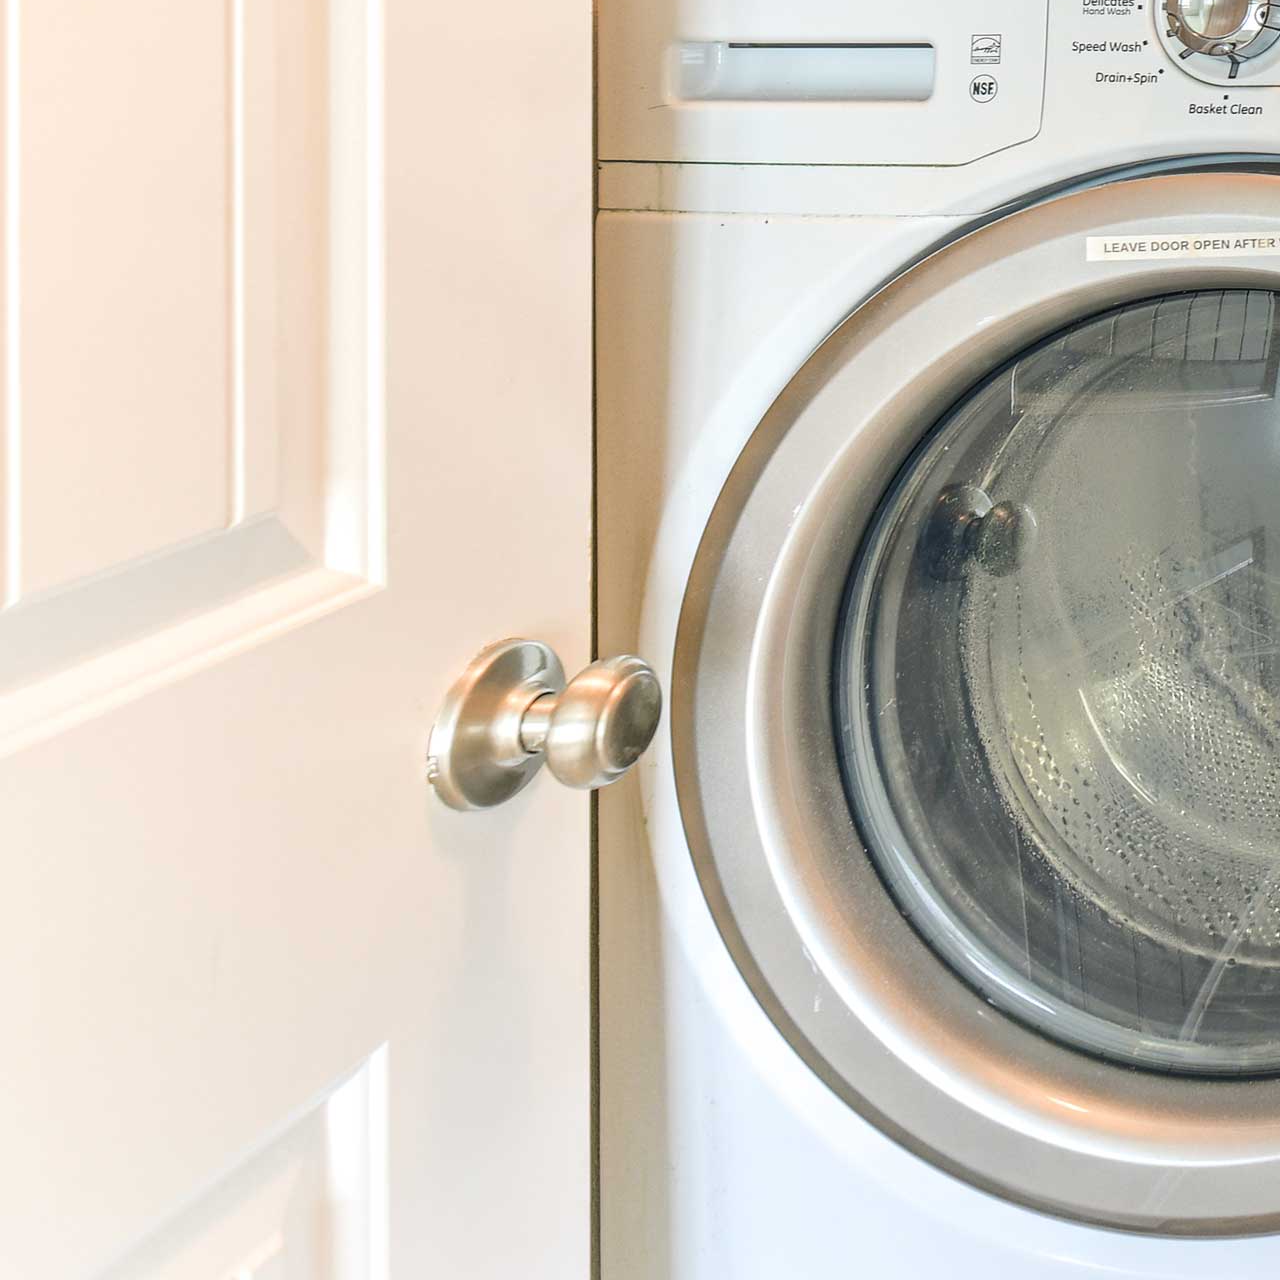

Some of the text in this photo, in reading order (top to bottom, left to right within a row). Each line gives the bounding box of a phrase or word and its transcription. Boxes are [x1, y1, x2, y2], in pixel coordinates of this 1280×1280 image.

[1082, 7, 1131, 16] Hand Wash
[1072, 41, 1141, 54] Speed Wash
[1095, 72, 1158, 84] Drain+Spin
[1189, 103, 1263, 115] Basket Clean
[1104, 241, 1147, 253] LEAVE
[1150, 240, 1189, 252] DOOR
[1193, 239, 1230, 251] OPEN
[1233, 238, 1275, 250] AFTER
